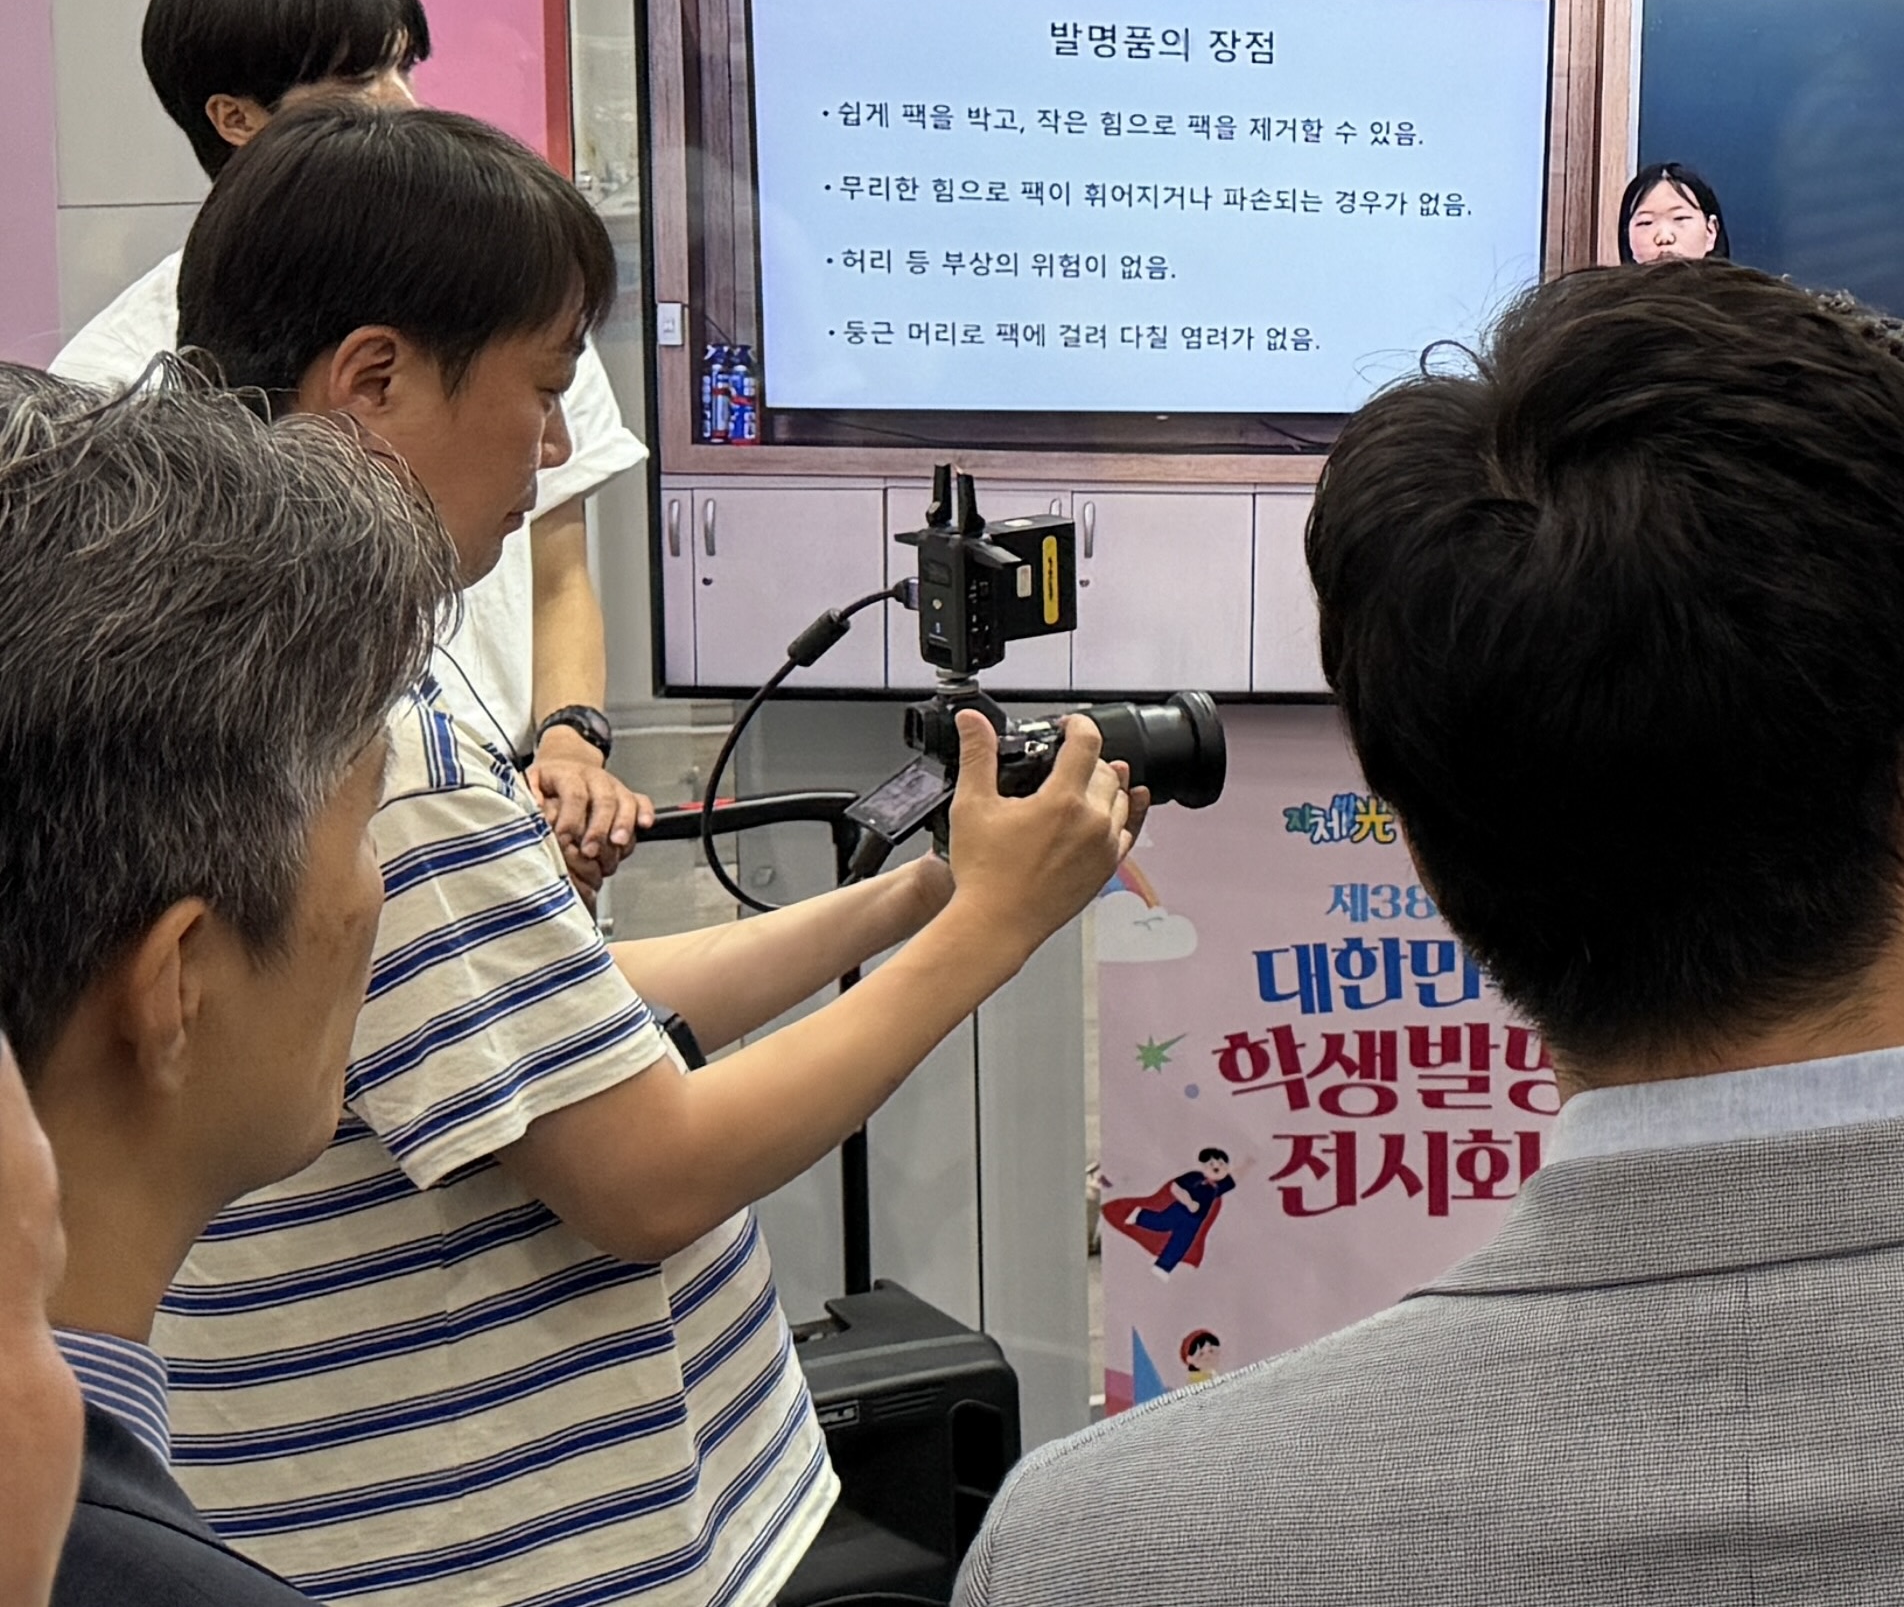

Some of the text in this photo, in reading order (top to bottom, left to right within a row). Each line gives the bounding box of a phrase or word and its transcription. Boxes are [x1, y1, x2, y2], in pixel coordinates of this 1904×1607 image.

[1050, 20, 1277, 66] 발명품의 장점
[838, 102, 1424, 147] 쉽게 팩을 박고, 작은 힘으로 팩을 제거할 수 있음.
[840, 175, 1472, 217] 무리한 힘으로 팩이 휘어지거나 파손되는 경우가 없음.
[842, 249, 1177, 281] 허리 등 부상의 위험이 없음.
[843, 321, 1321, 352] 둥근 머리로 팩에 걸려 다칠 염려가 없음.
[1325, 881, 1438, 924] 제38
[1251, 936, 1482, 1016] 대한민
[1269, 1127, 1541, 1218] 전시회
